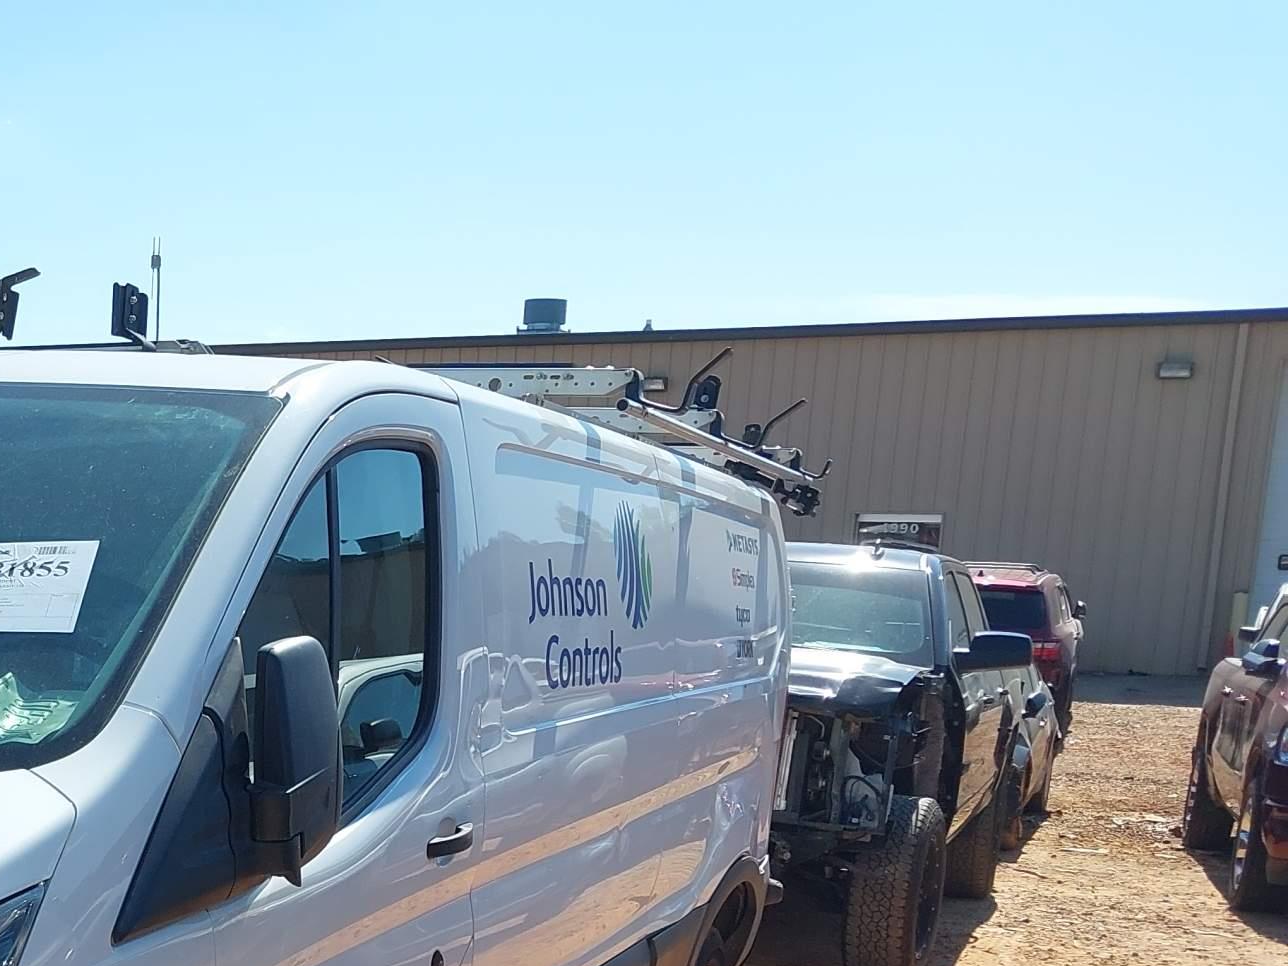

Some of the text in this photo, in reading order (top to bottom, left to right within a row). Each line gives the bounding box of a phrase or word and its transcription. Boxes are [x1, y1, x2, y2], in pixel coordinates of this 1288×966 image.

[731, 532, 759, 556] METASYS
[528, 558, 608, 625] Johnson
[735, 604, 751, 628] tyco
[545, 629, 622, 689] Controls
